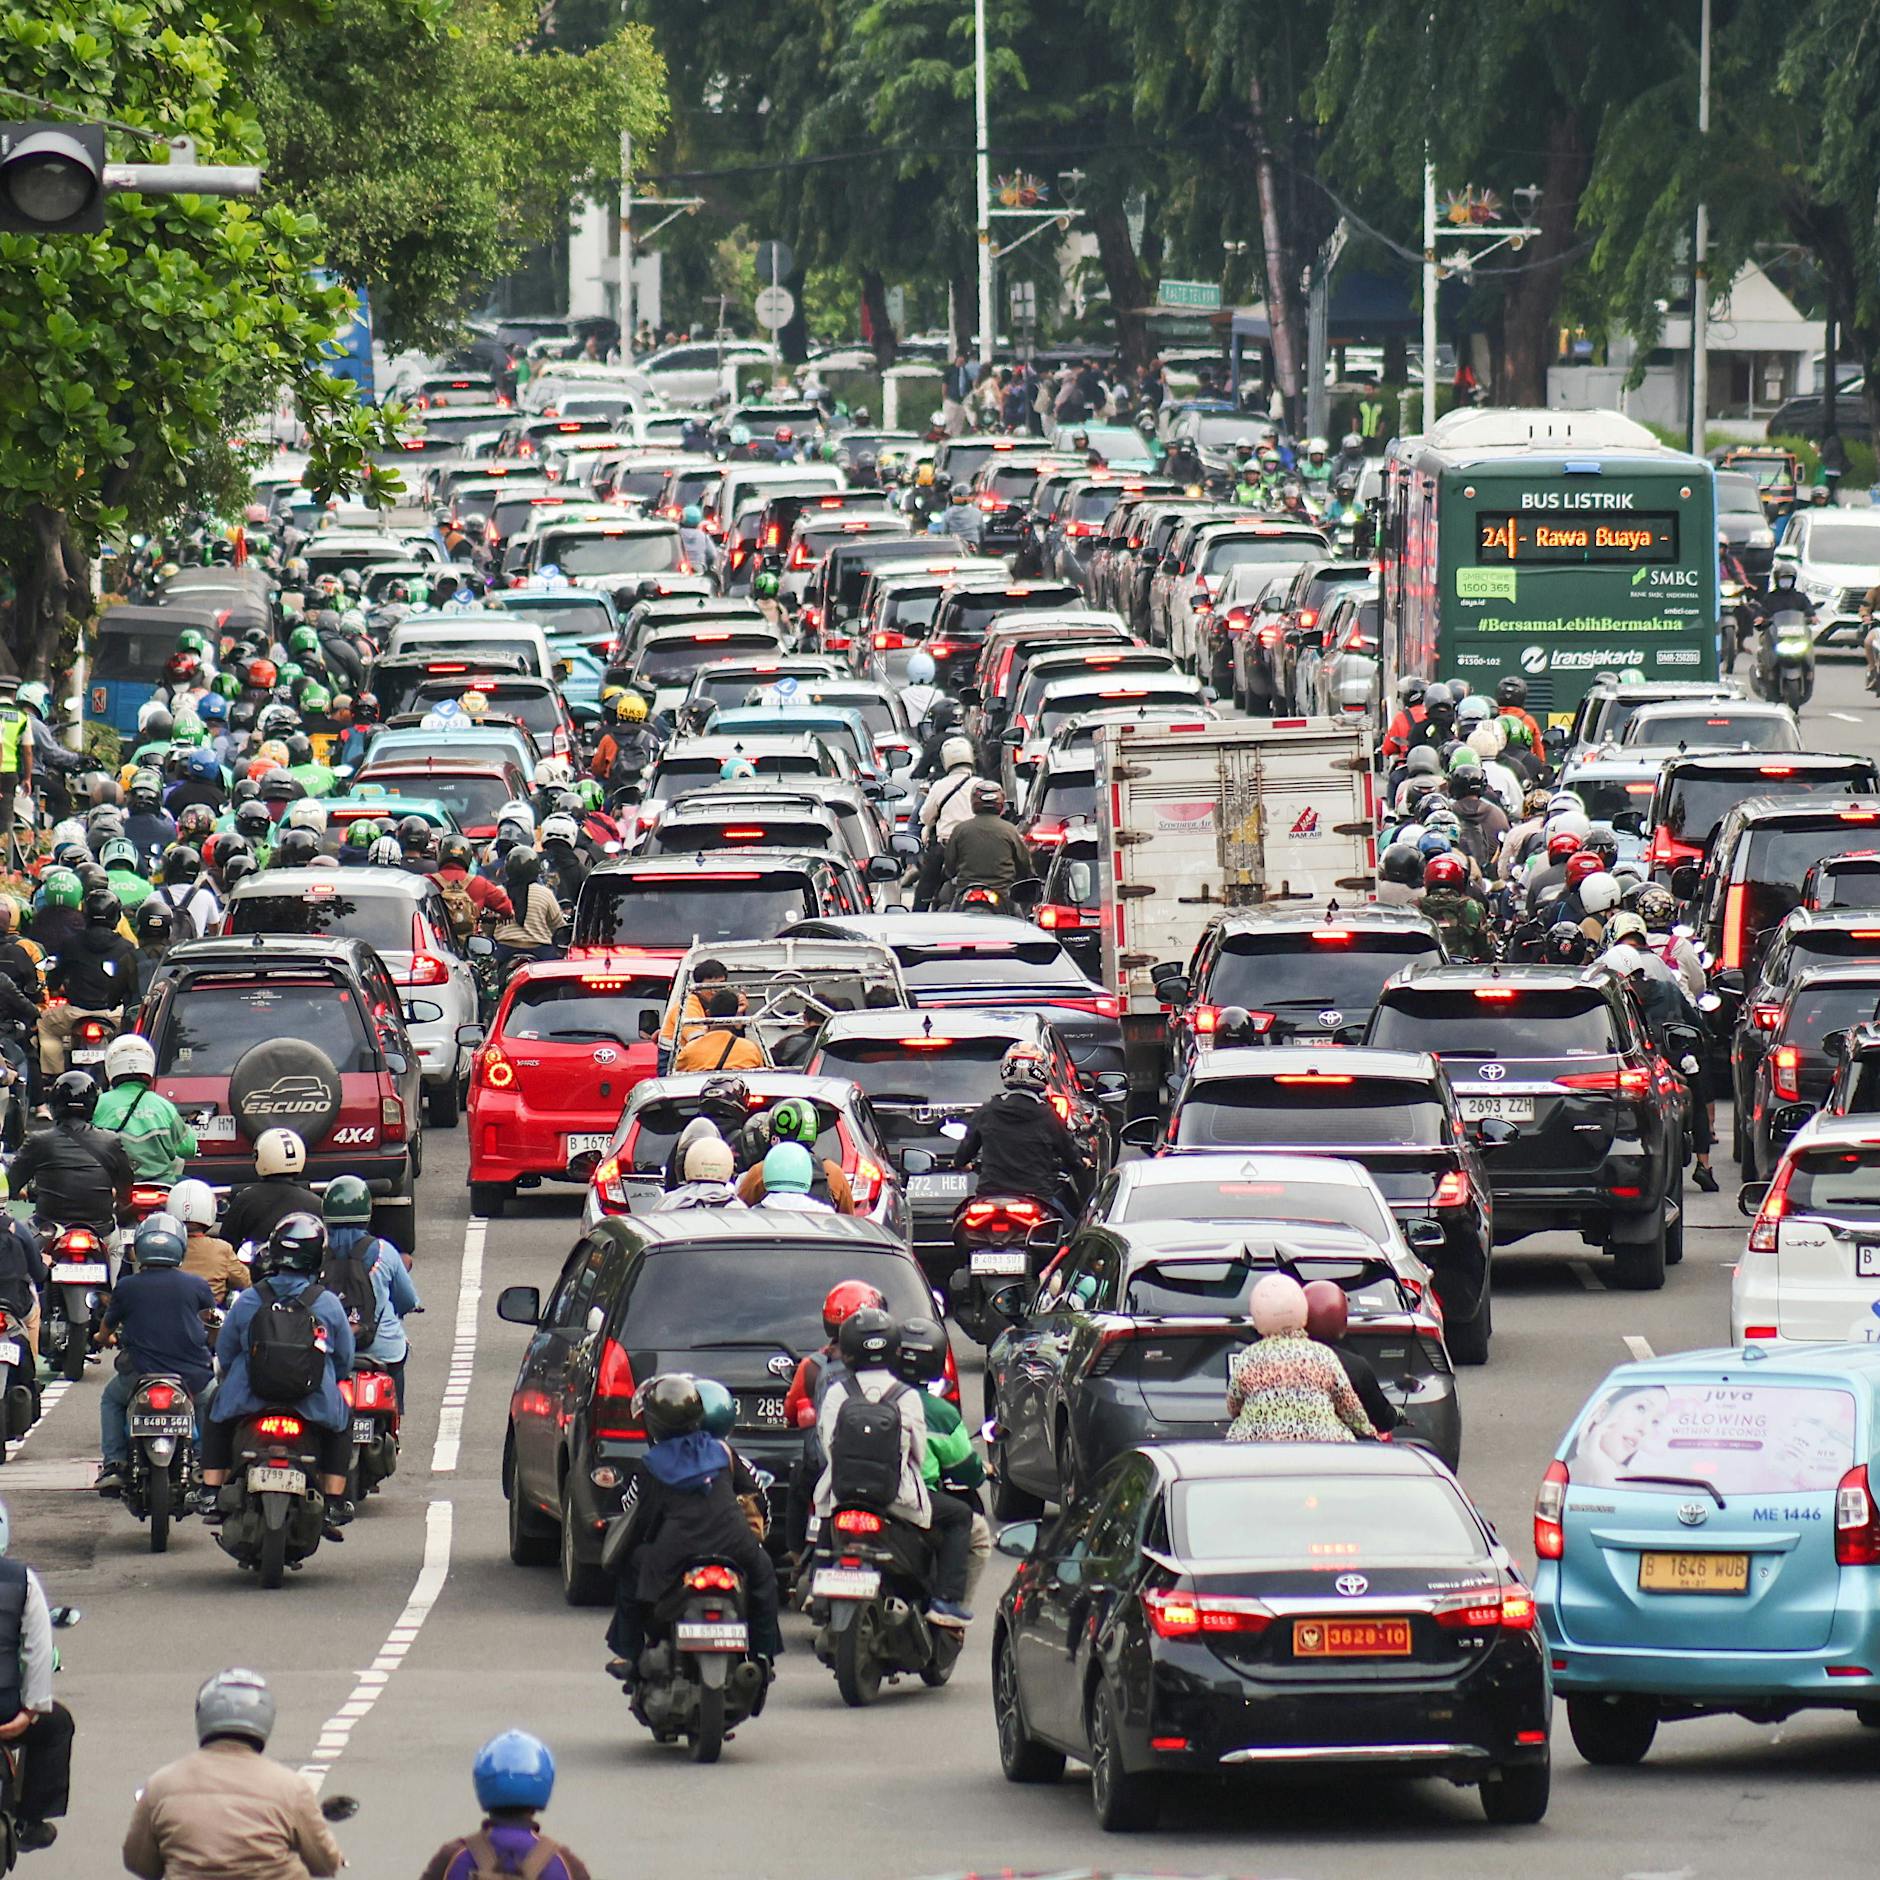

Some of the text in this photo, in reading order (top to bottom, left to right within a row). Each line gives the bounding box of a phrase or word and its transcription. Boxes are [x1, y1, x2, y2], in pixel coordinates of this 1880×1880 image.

[1521, 493, 1633, 509] BUS LISTRIK
[1536, 527, 1588, 547] Rawa
[1595, 527, 1651, 551] Buaya
[1650, 570, 1698, 586] SMBC
[1463, 583, 1510, 592] 1500 365
[1478, 617, 1683, 631] #BersamaLebihBermakna
[1550, 649, 1645, 669] transjakarta
[50, 880, 74, 893] Grab
[109, 879, 137, 892] Grab
[243, 1101, 331, 1114] ESCUDO
[1469, 1099, 1532, 1113] 2693 ZZH
[218, 1117, 233, 1131] HM
[334, 1127, 374, 1143] 4X4
[570, 1138, 577, 1150] B
[942, 1176, 967, 1191] HER
[1864, 1249, 1872, 1263] B
[1705, 1391, 1754, 1402] juva
[133, 1417, 140, 1426] B
[1679, 1413, 1767, 1427] GLOWING
[1753, 1507, 1821, 1521] ME 1446
[1645, 1556, 1745, 1577] B 1646 WUB
